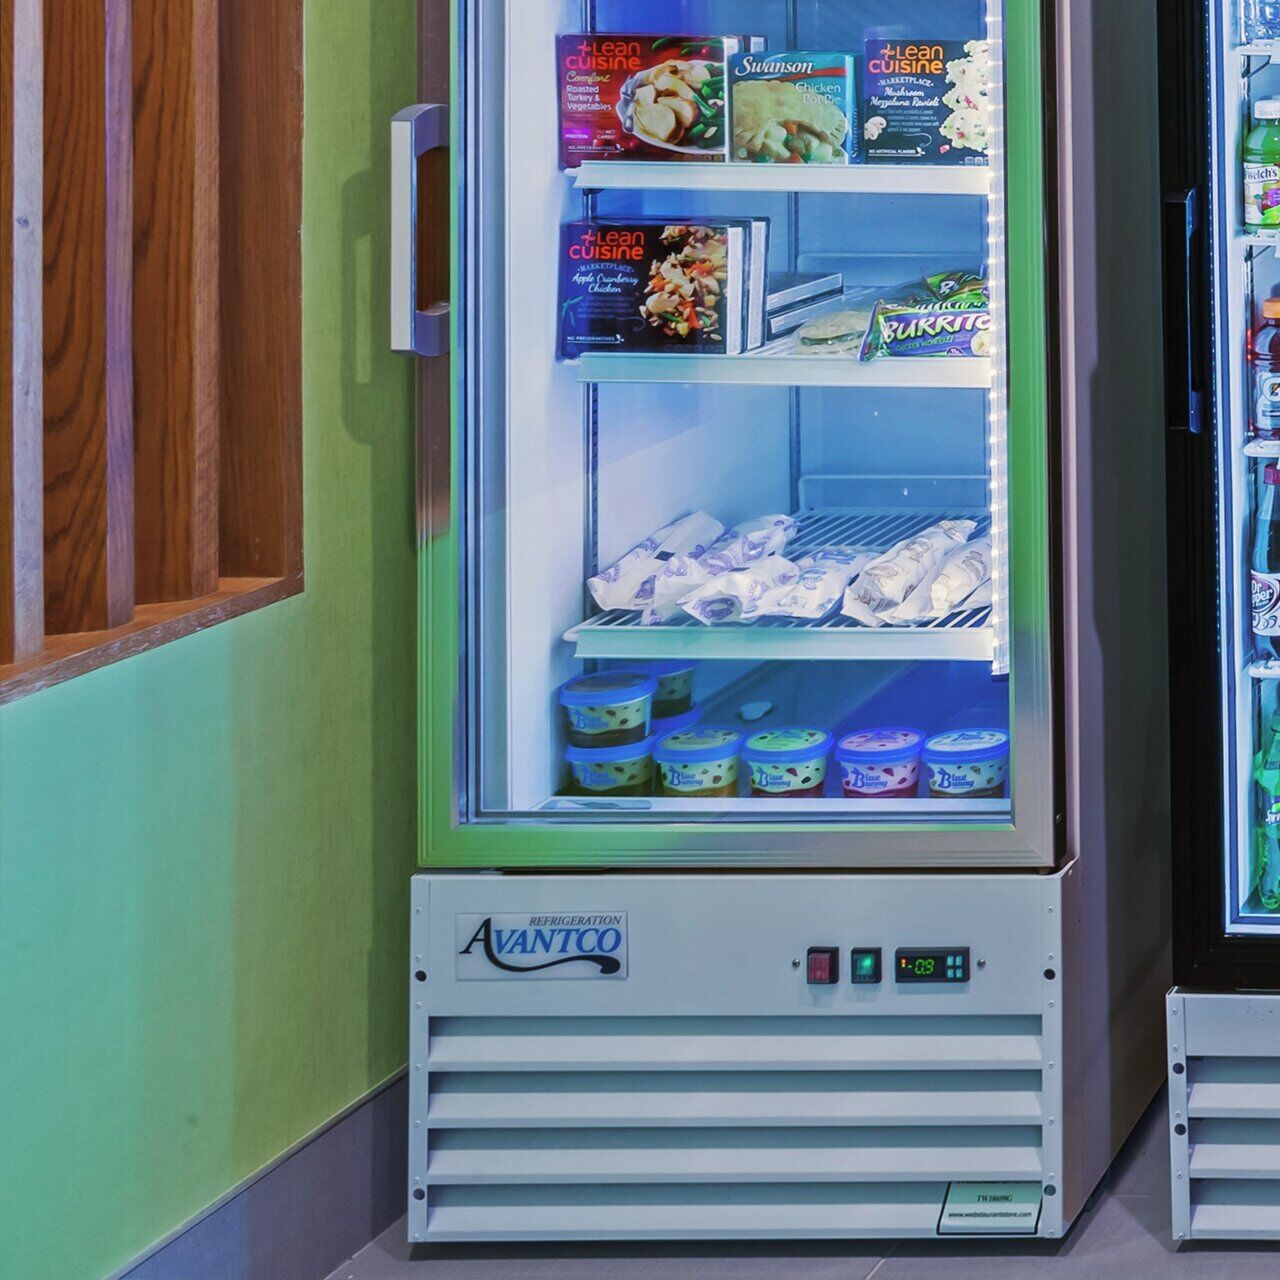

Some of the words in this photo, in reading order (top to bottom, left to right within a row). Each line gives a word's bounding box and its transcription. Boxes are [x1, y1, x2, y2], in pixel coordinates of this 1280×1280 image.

[592, 41, 641, 56] Lean
[896, 45, 944, 60] Lean
[735, 56, 814, 77] Swanson
[795, 81, 842, 94] Chicken
[880, 76, 931, 87] MARKETPLACE
[566, 84, 600, 93] Roasted
[883, 87, 925, 97] Mushroom
[566, 93, 594, 103] Turkey
[870, 96, 910, 108] Mezzaluna
[911, 96, 940, 107] Ravioli
[567, 102, 612, 112] Vegetables
[1246, 168, 1278, 181] Welch's
[597, 231, 645, 246] Lean
[571, 273, 595, 285] Apple
[596, 272, 639, 286] Cranberry
[588, 283, 622, 294] Chicken
[529, 915, 623, 926] REFRIGERATION
[459, 917, 622, 963] AVANTCO
